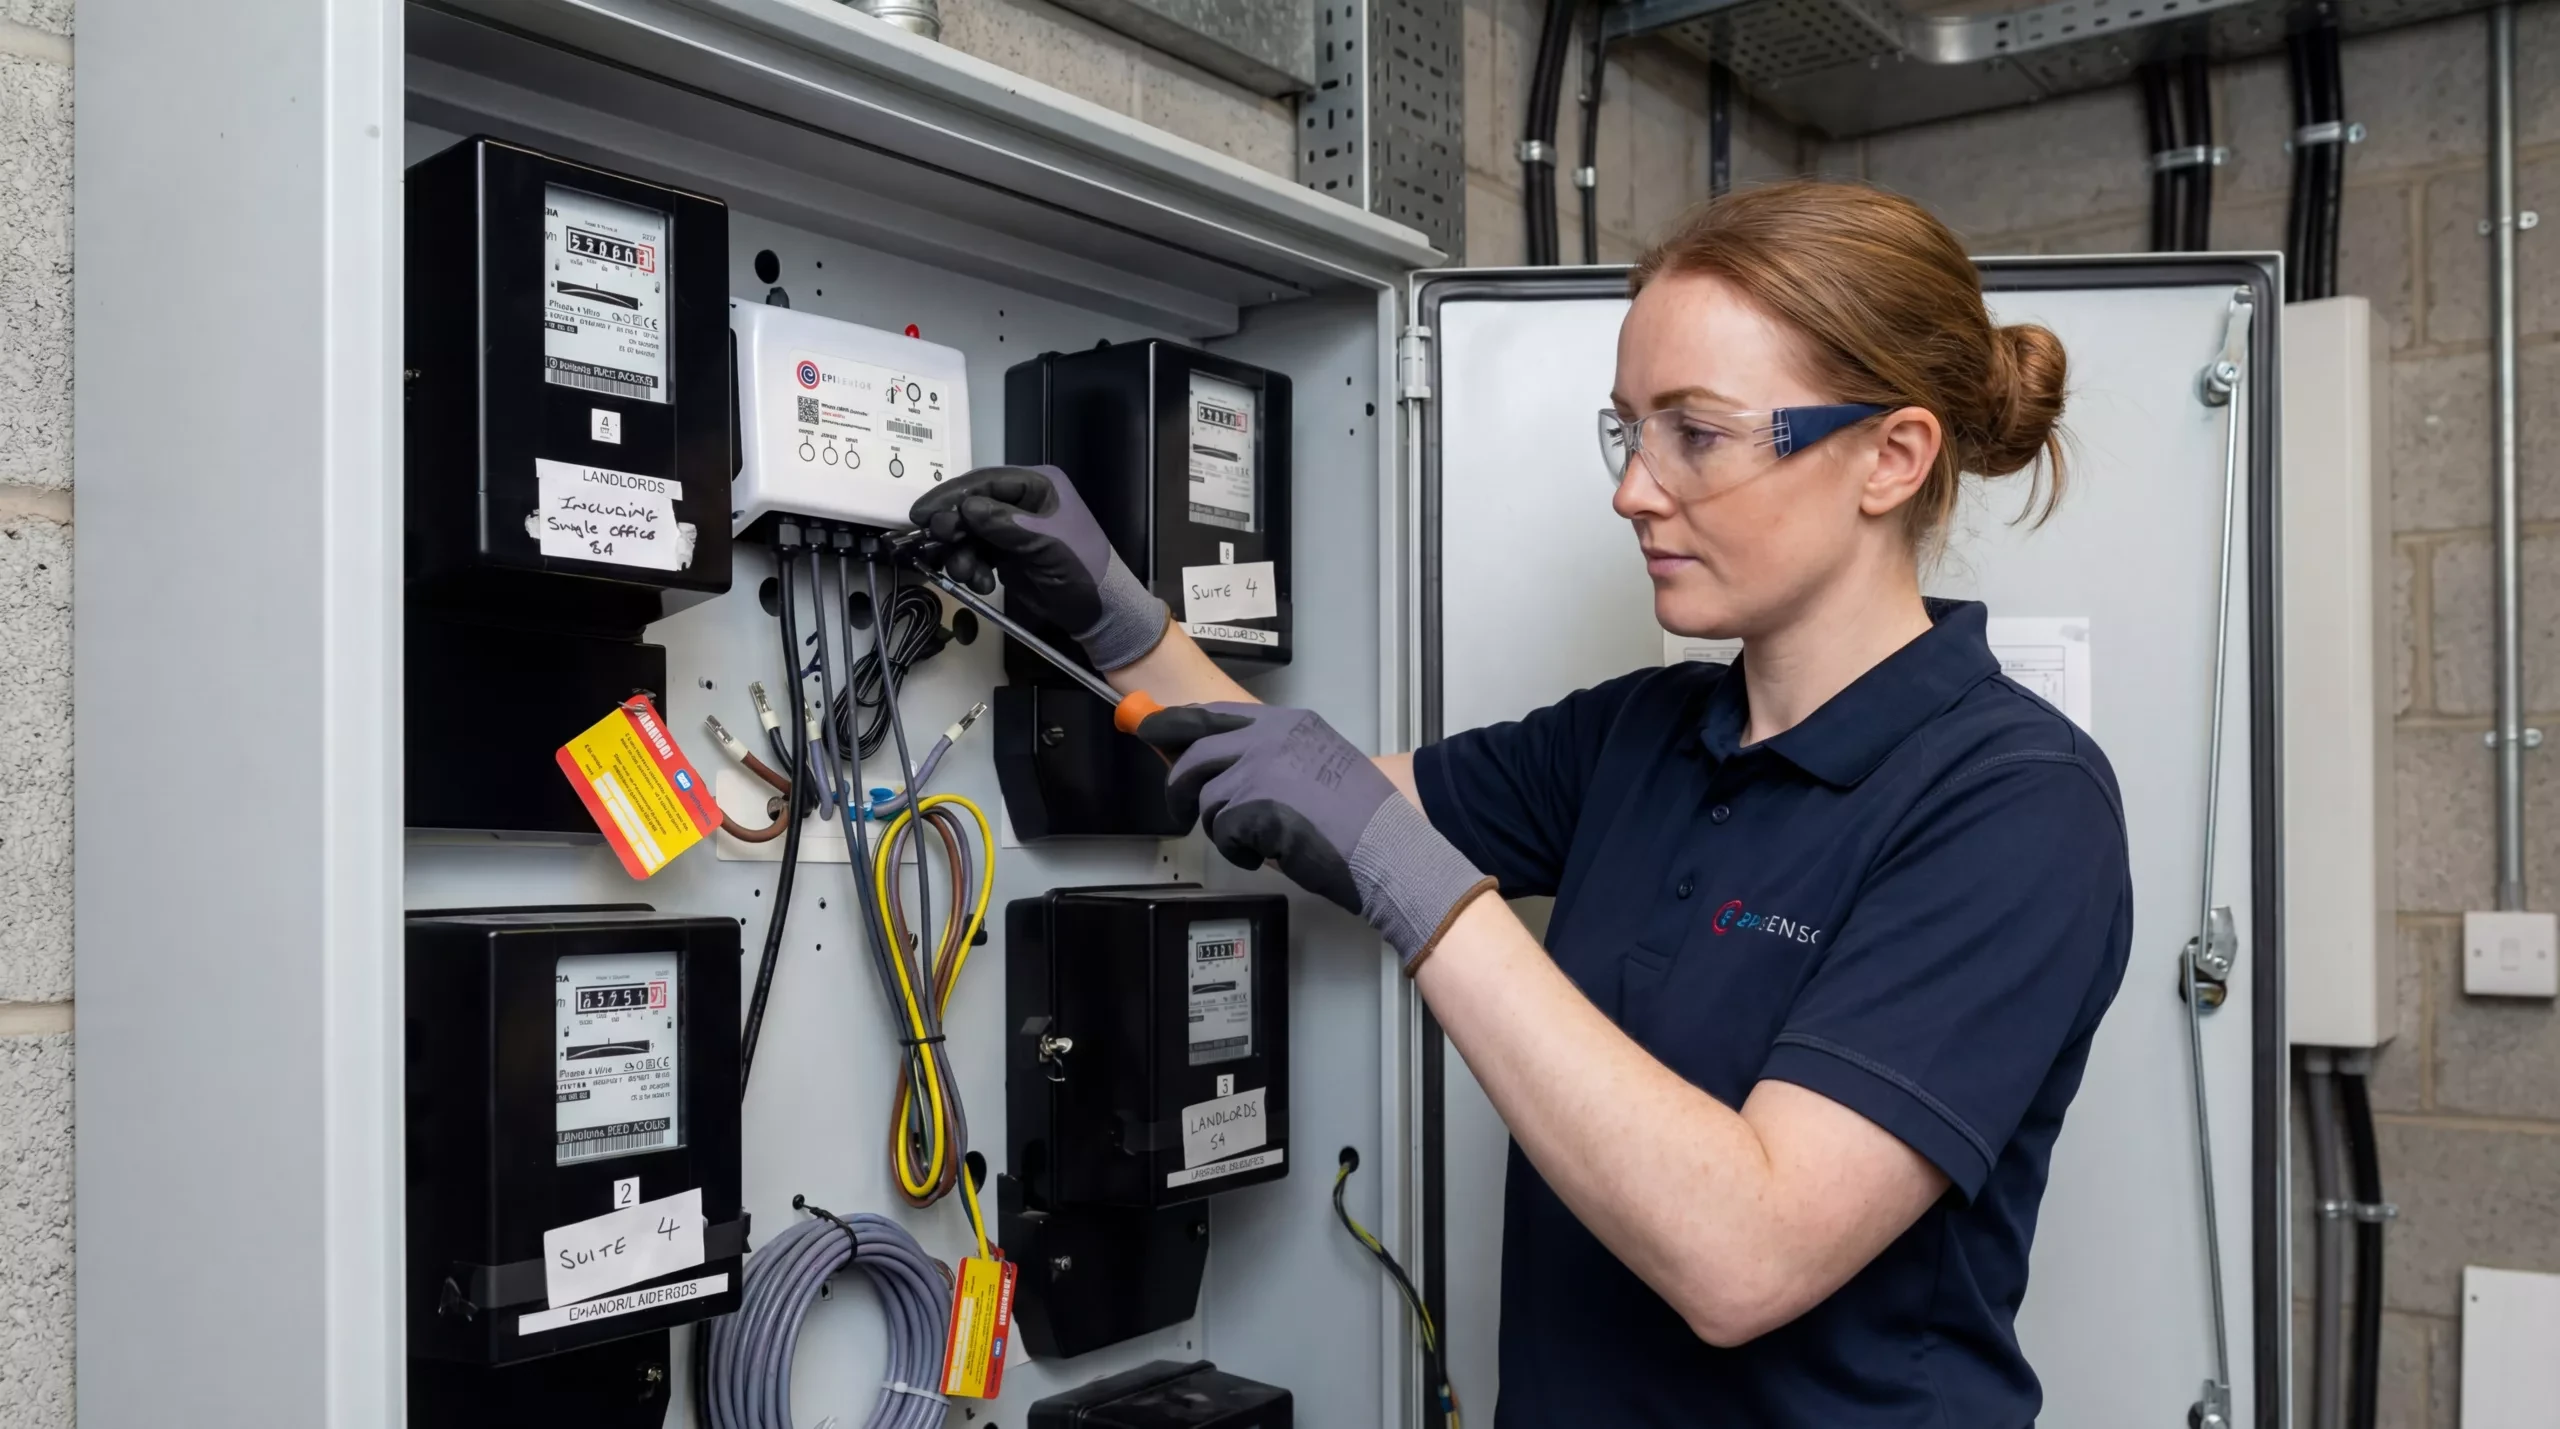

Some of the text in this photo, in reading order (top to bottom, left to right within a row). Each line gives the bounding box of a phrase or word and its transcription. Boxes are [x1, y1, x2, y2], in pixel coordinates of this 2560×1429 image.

[583, 469, 665, 494] LANDLORDS
[1191, 578, 1258, 600] SUITE 4
[1191, 1101, 1257, 1135] LANDLORDS
[621, 1183, 632, 1204] 2
[560, 1217, 681, 1269] SUITE 4
